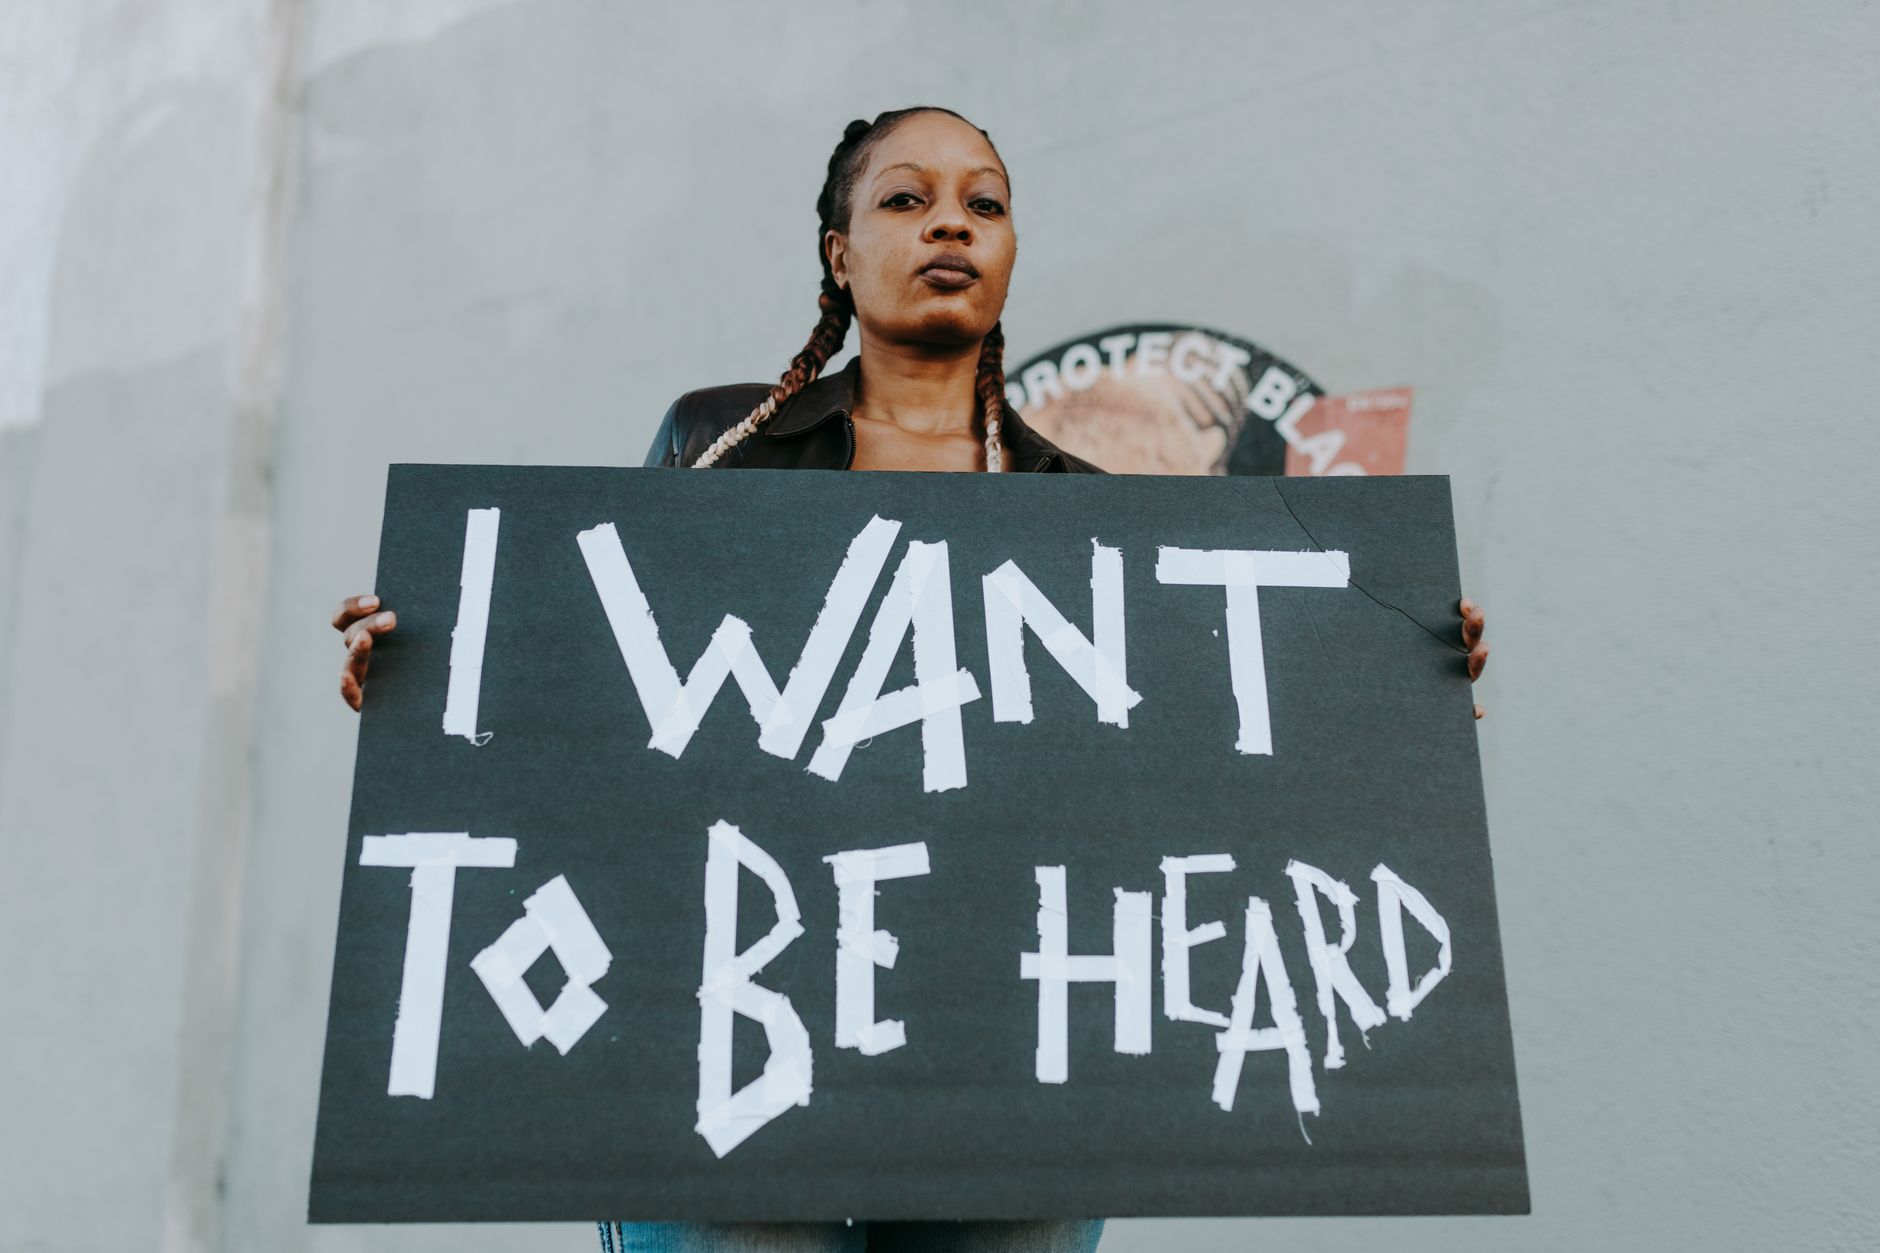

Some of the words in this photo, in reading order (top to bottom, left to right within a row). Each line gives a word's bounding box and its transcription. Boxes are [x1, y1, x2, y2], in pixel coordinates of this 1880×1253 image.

[1248, 366, 1367, 476] BLA
[443, 507, 500, 747] I
[576, 514, 1350, 793] WANT
[359, 832, 612, 1099] TO
[695, 819, 930, 1158] BE
[1019, 854, 1452, 1117] HEARD
